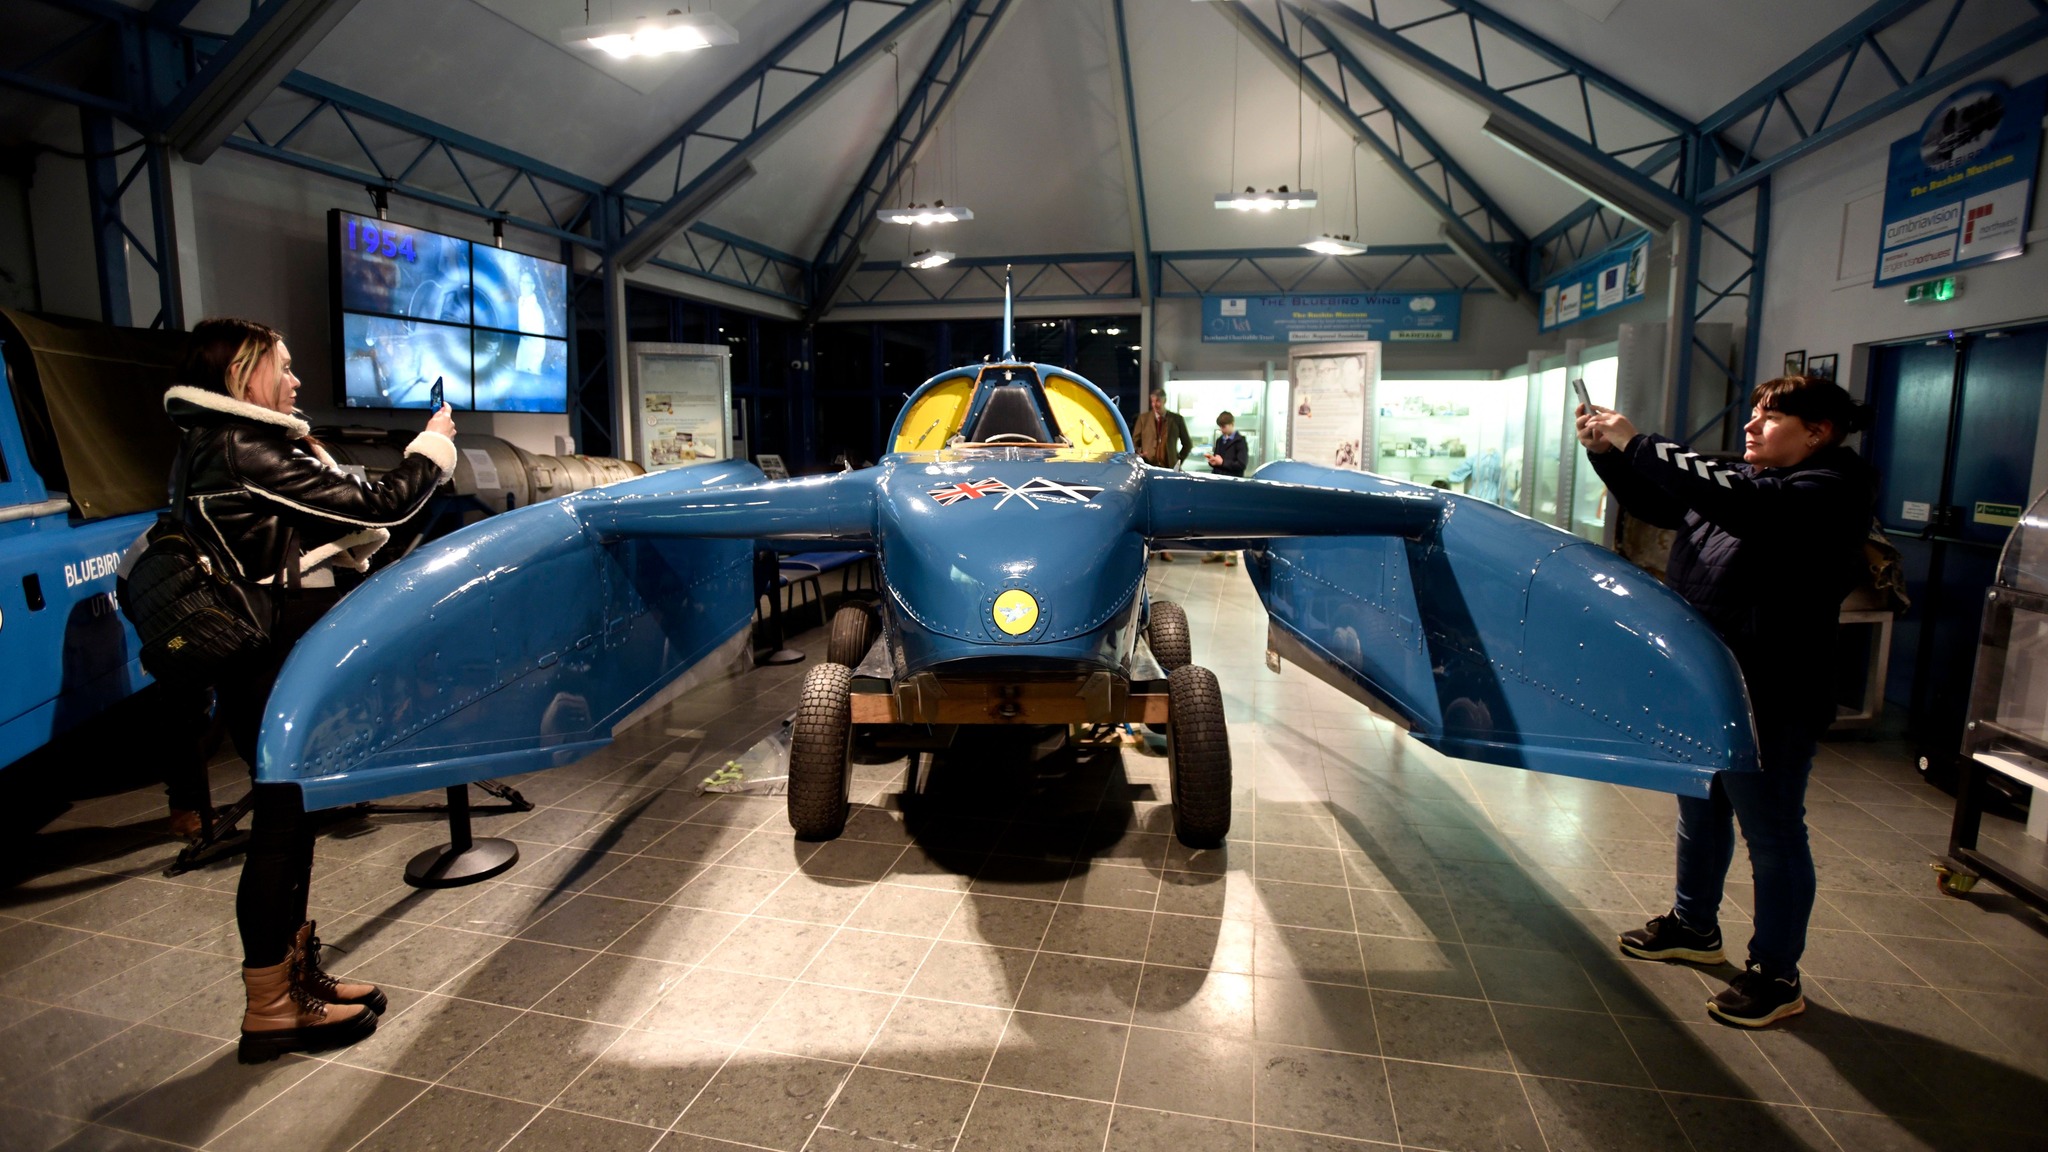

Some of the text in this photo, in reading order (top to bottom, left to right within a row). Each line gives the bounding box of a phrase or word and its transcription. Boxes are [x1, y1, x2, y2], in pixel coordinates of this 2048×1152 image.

[1910, 185, 1928, 197] The
[1929, 173, 1964, 191] Ruskin
[1965, 154, 2015, 178] Museum
[1886, 206, 1958, 239] cumbriavision
[347, 220, 417, 262] 1954
[1260, 295, 1401, 307] THE BLUEBIRD WING
[1292, 311, 1368, 319] The Ruskin Museum
[64, 551, 121, 588] BLUEBIRD
